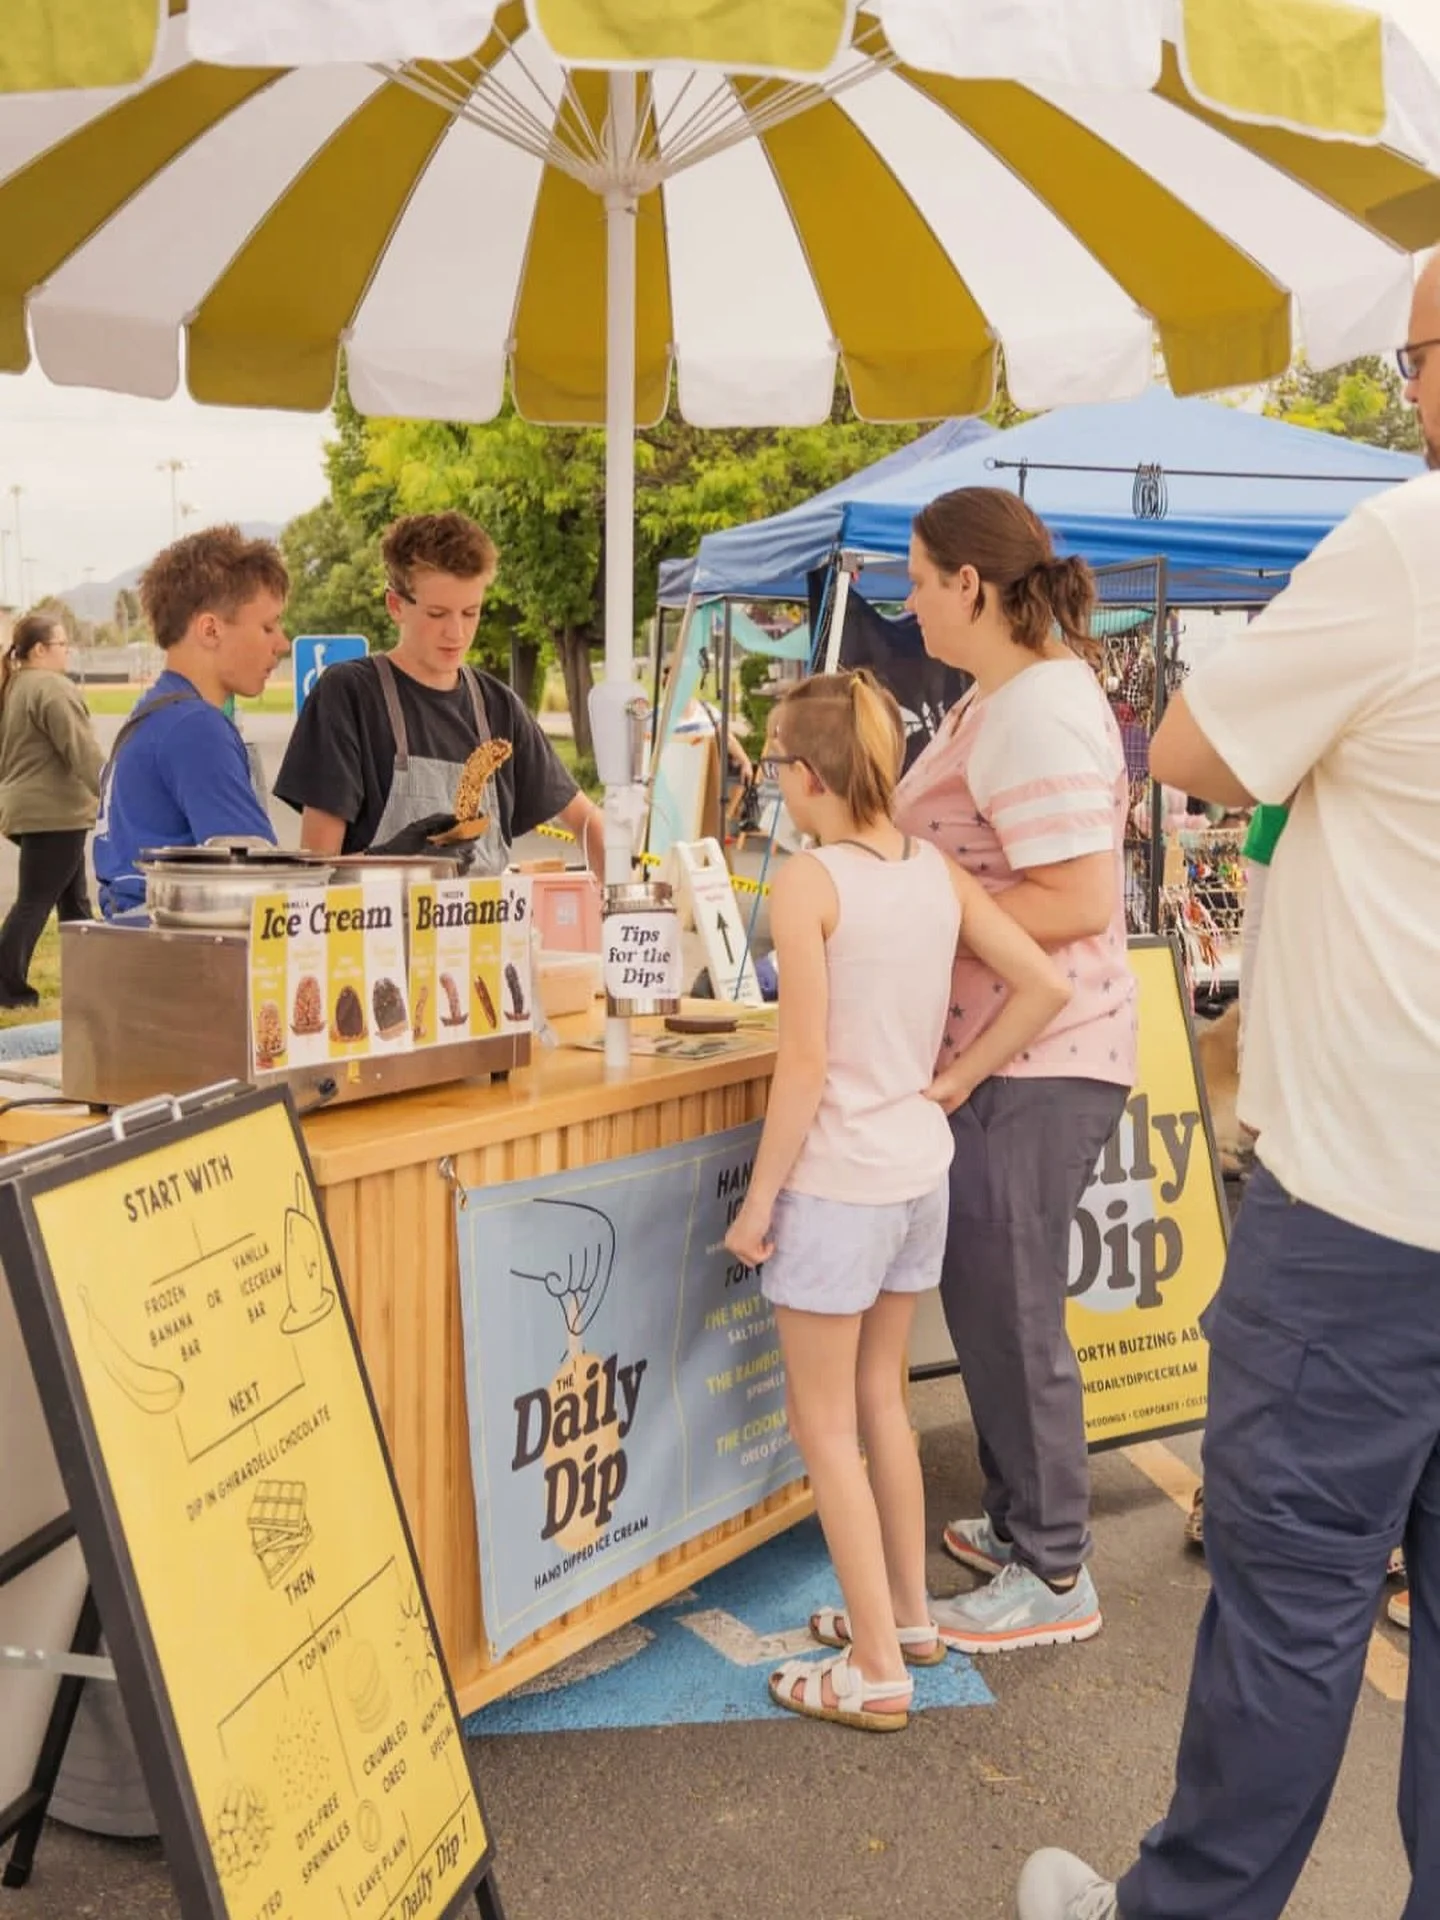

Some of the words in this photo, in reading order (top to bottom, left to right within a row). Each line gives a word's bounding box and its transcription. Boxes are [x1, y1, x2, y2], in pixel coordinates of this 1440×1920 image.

[261, 907, 302, 941] Ice
[309, 902, 393, 935] Cream
[416, 889, 526, 931] Banana's
[620, 925, 660, 946] Tips
[608, 947, 637, 964] for
[644, 947, 671, 964] the
[622, 967, 665, 988] Dips
[123, 1173, 182, 1223] START
[183, 1153, 234, 1196] WITH
[717, 1160, 754, 1198] HAN
[232, 1241, 270, 1271] VANILLA
[240, 1262, 283, 1297] ICECREAM
[144, 1284, 187, 1318] FROZEN
[206, 1288, 223, 1309] OR
[247, 1300, 267, 1324] BAR
[149, 1312, 194, 1347] BANANA
[1077, 1341, 1116, 1363] ORTH
[1119, 1331, 1177, 1356] BUZZING
[181, 1338, 202, 1363] BAR
[556, 1373, 575, 1392] THE
[706, 1370, 733, 1396] THE
[1083, 1361, 1198, 1395] HEDAILYDIPICECREAM
[228, 1381, 261, 1418] NEXT
[511, 1353, 648, 1472] Daily
[1132, 1401, 1180, 1420] CORPORATE
[716, 1428, 739, 1457] THE
[186, 1497, 203, 1522] DIP
[205, 1490, 217, 1507] IN
[218, 1444, 279, 1499] GHIRARDELLI
[278, 1404, 331, 1455] CHOCOLATE
[541, 1444, 628, 1541] Dip
[534, 1564, 562, 1591] HAND
[563, 1542, 594, 1573] DIPPED
[595, 1532, 611, 1553] ICE
[613, 1515, 649, 1543] CREAM
[284, 1566, 316, 1607] THEN
[299, 1647, 317, 1678] TOP
[318, 1624, 342, 1656] WITH
[362, 1719, 409, 1776] CRUMBLED
[382, 1757, 407, 1794] OREO
[296, 1791, 340, 1851] DYE-FREE
[302, 1819, 351, 1884] SPRINKLES
[354, 1864, 382, 1908] LEAVE
[381, 1834, 407, 1871] PLAIN
[401, 1865, 433, 1920] Daily
